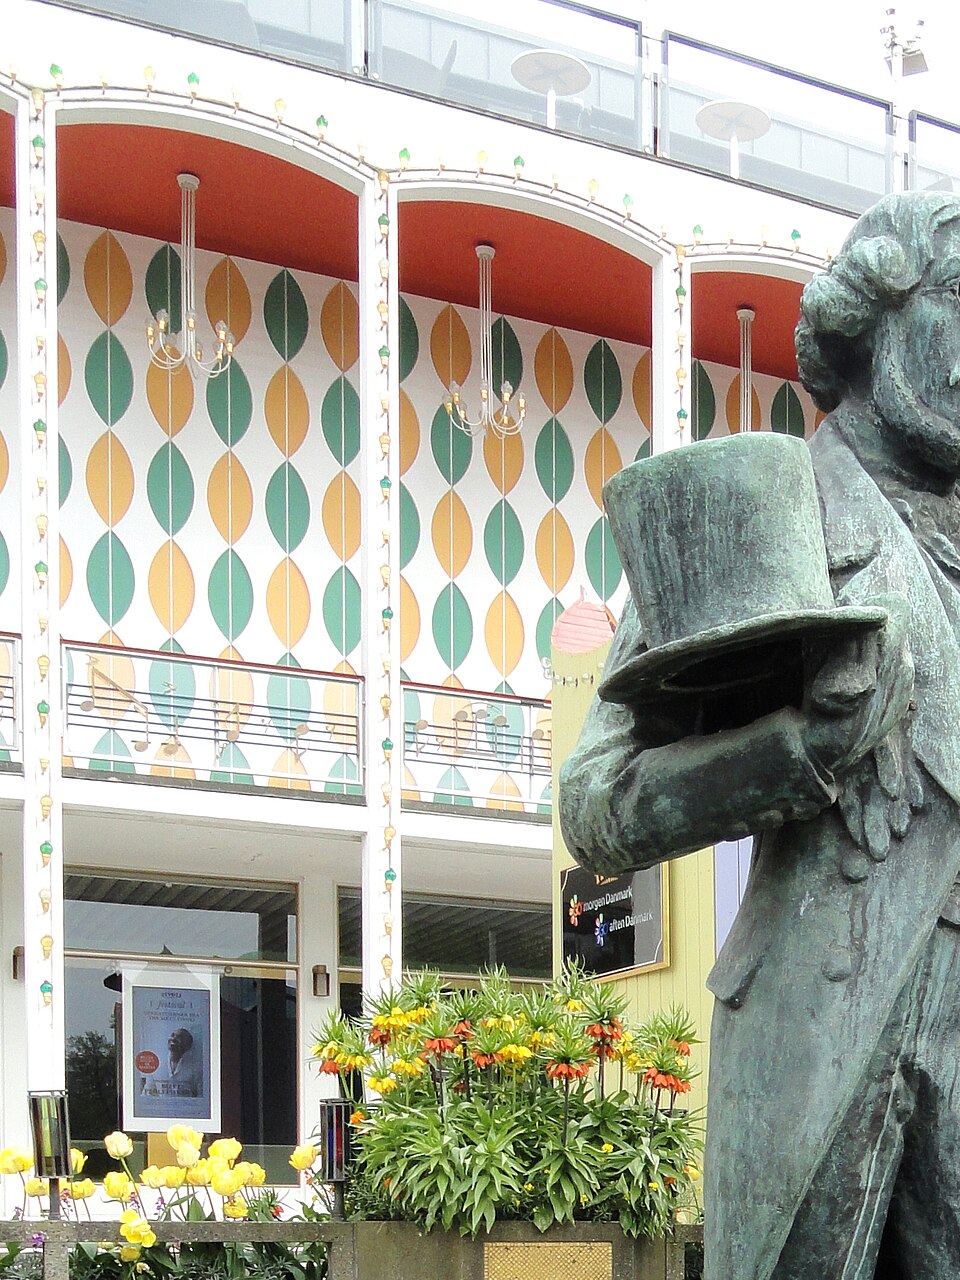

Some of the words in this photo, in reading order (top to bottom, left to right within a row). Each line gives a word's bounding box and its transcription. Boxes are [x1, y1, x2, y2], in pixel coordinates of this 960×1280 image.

[583, 897, 606, 911] morgen
[605, 885, 633, 905] Danmark
[609, 917, 625, 932] aften
[625, 910, 654, 928] Danmark
